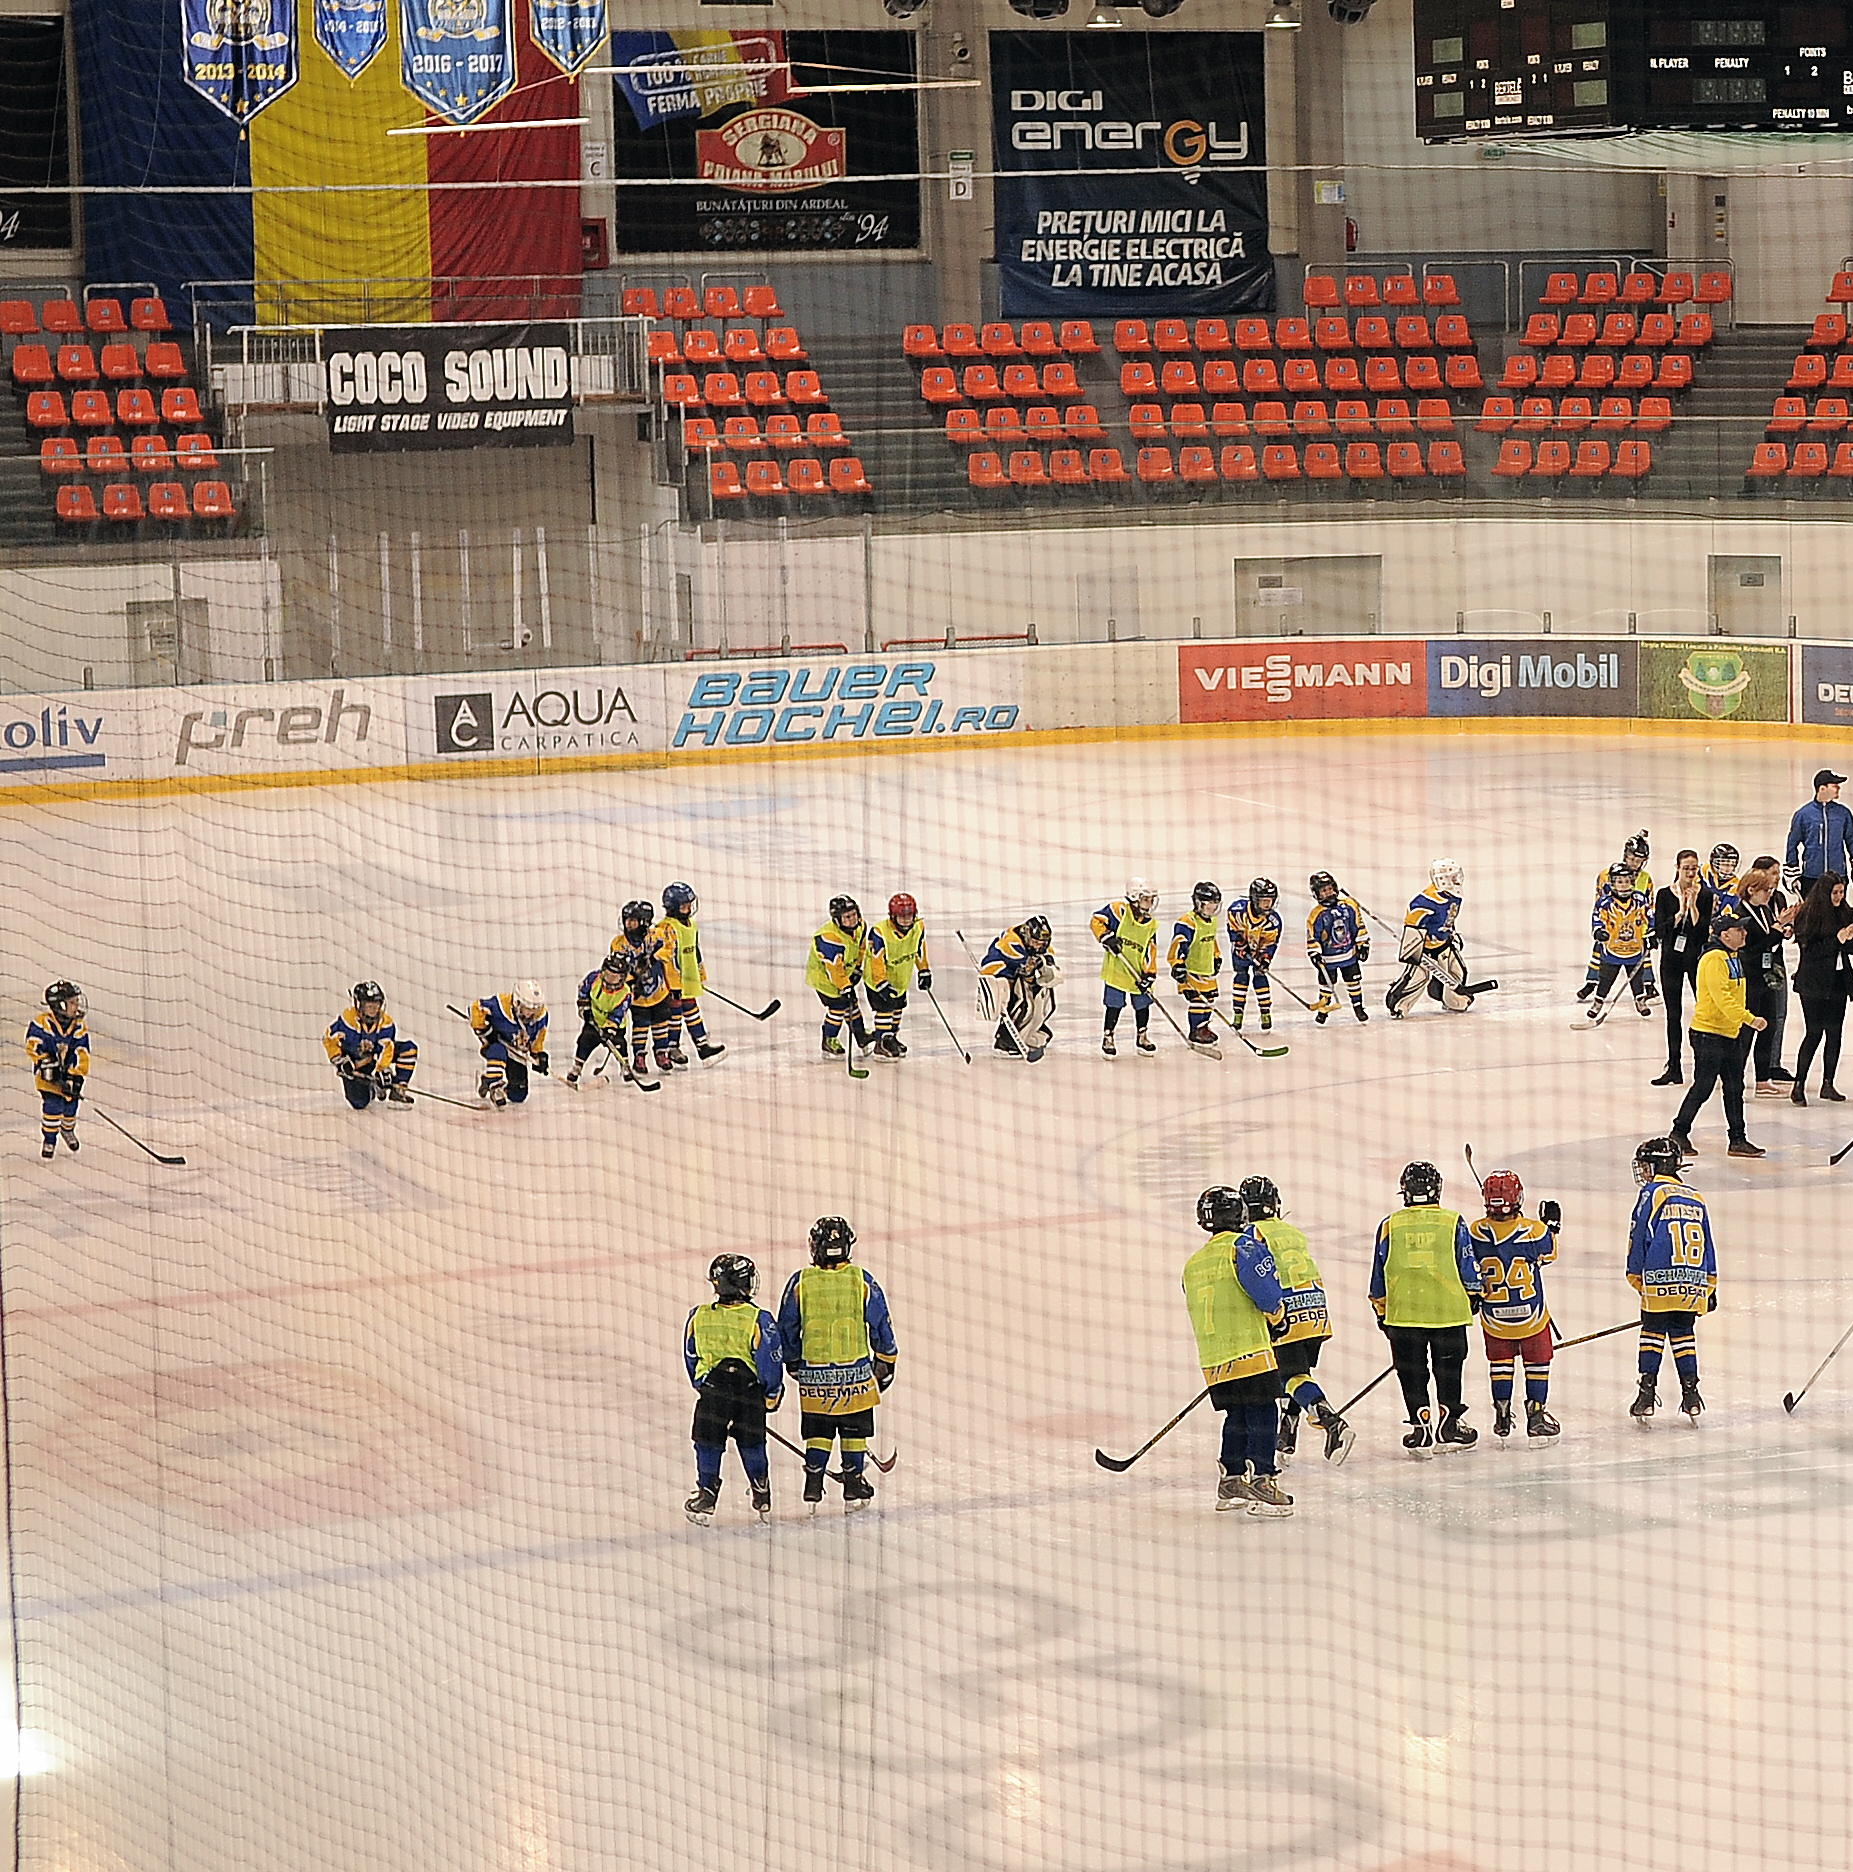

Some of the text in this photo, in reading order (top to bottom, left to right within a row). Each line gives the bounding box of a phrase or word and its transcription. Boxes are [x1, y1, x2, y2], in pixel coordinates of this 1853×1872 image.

[195, 63, 287, 81] 2013 2014
[412, 54, 452, 73] 2016
[468, 53, 504, 73] 2017
[1811, 66, 1818, 76] 2
[647, 90, 700, 116] FERMA
[1011, 90, 1103, 111] DIGI
[722, 114, 819, 147] SERGIANA
[590, 162, 601, 176] C
[956, 182, 966, 196] D
[776, 200, 798, 210] DIN
[800, 199, 849, 210] ARDEAL
[1140, 210, 1191, 234] MICI
[1196, 209, 1227, 234] LA
[1021, 231, 1247, 262] ENERGIE ELECTRICĂ
[1052, 264, 1083, 287] LA
[1089, 263, 1142, 287] TINE
[330, 346, 569, 406] COCO SOUND
[334, 414, 377, 433] LIGHT
[381, 413, 431, 432] STAGE
[484, 408, 568, 431] EQUIPMENT
[1198, 654, 1413, 703] VIESSMANN
[1441, 654, 1620, 698] Digi Mobil
[501, 685, 638, 730] AQUA
[2, 705, 103, 748] oliv
[501, 730, 639, 752] CARPATICA
[1668, 1220, 1705, 1267] 18
[1480, 1256, 1537, 1303] 24
